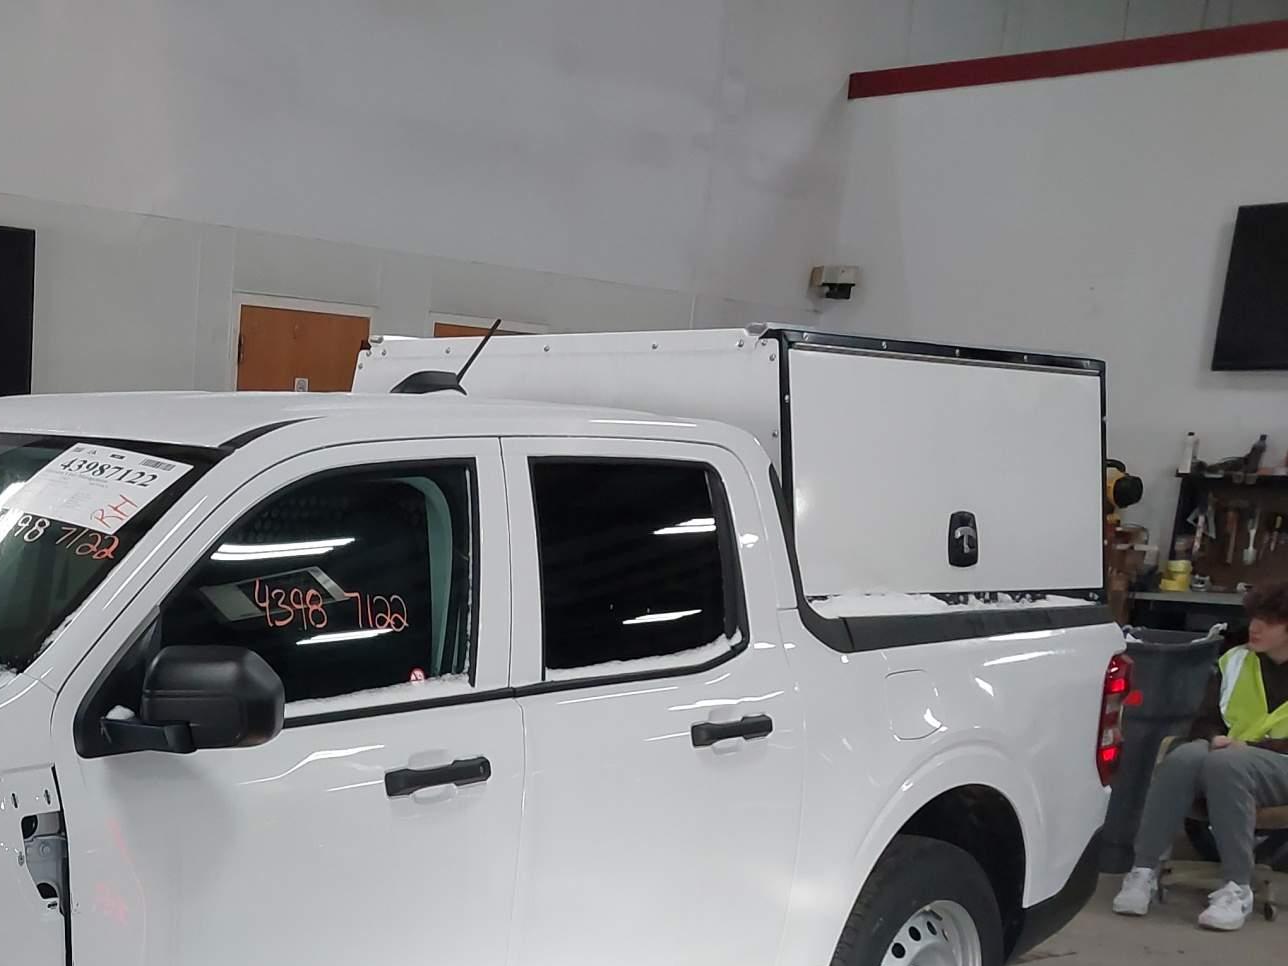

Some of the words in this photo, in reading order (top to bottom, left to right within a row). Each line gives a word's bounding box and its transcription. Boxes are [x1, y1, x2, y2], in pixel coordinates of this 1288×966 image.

[60, 458, 158, 487] 43987122
[254, 577, 328, 630] 4398
[344, 592, 409, 632] 7122
